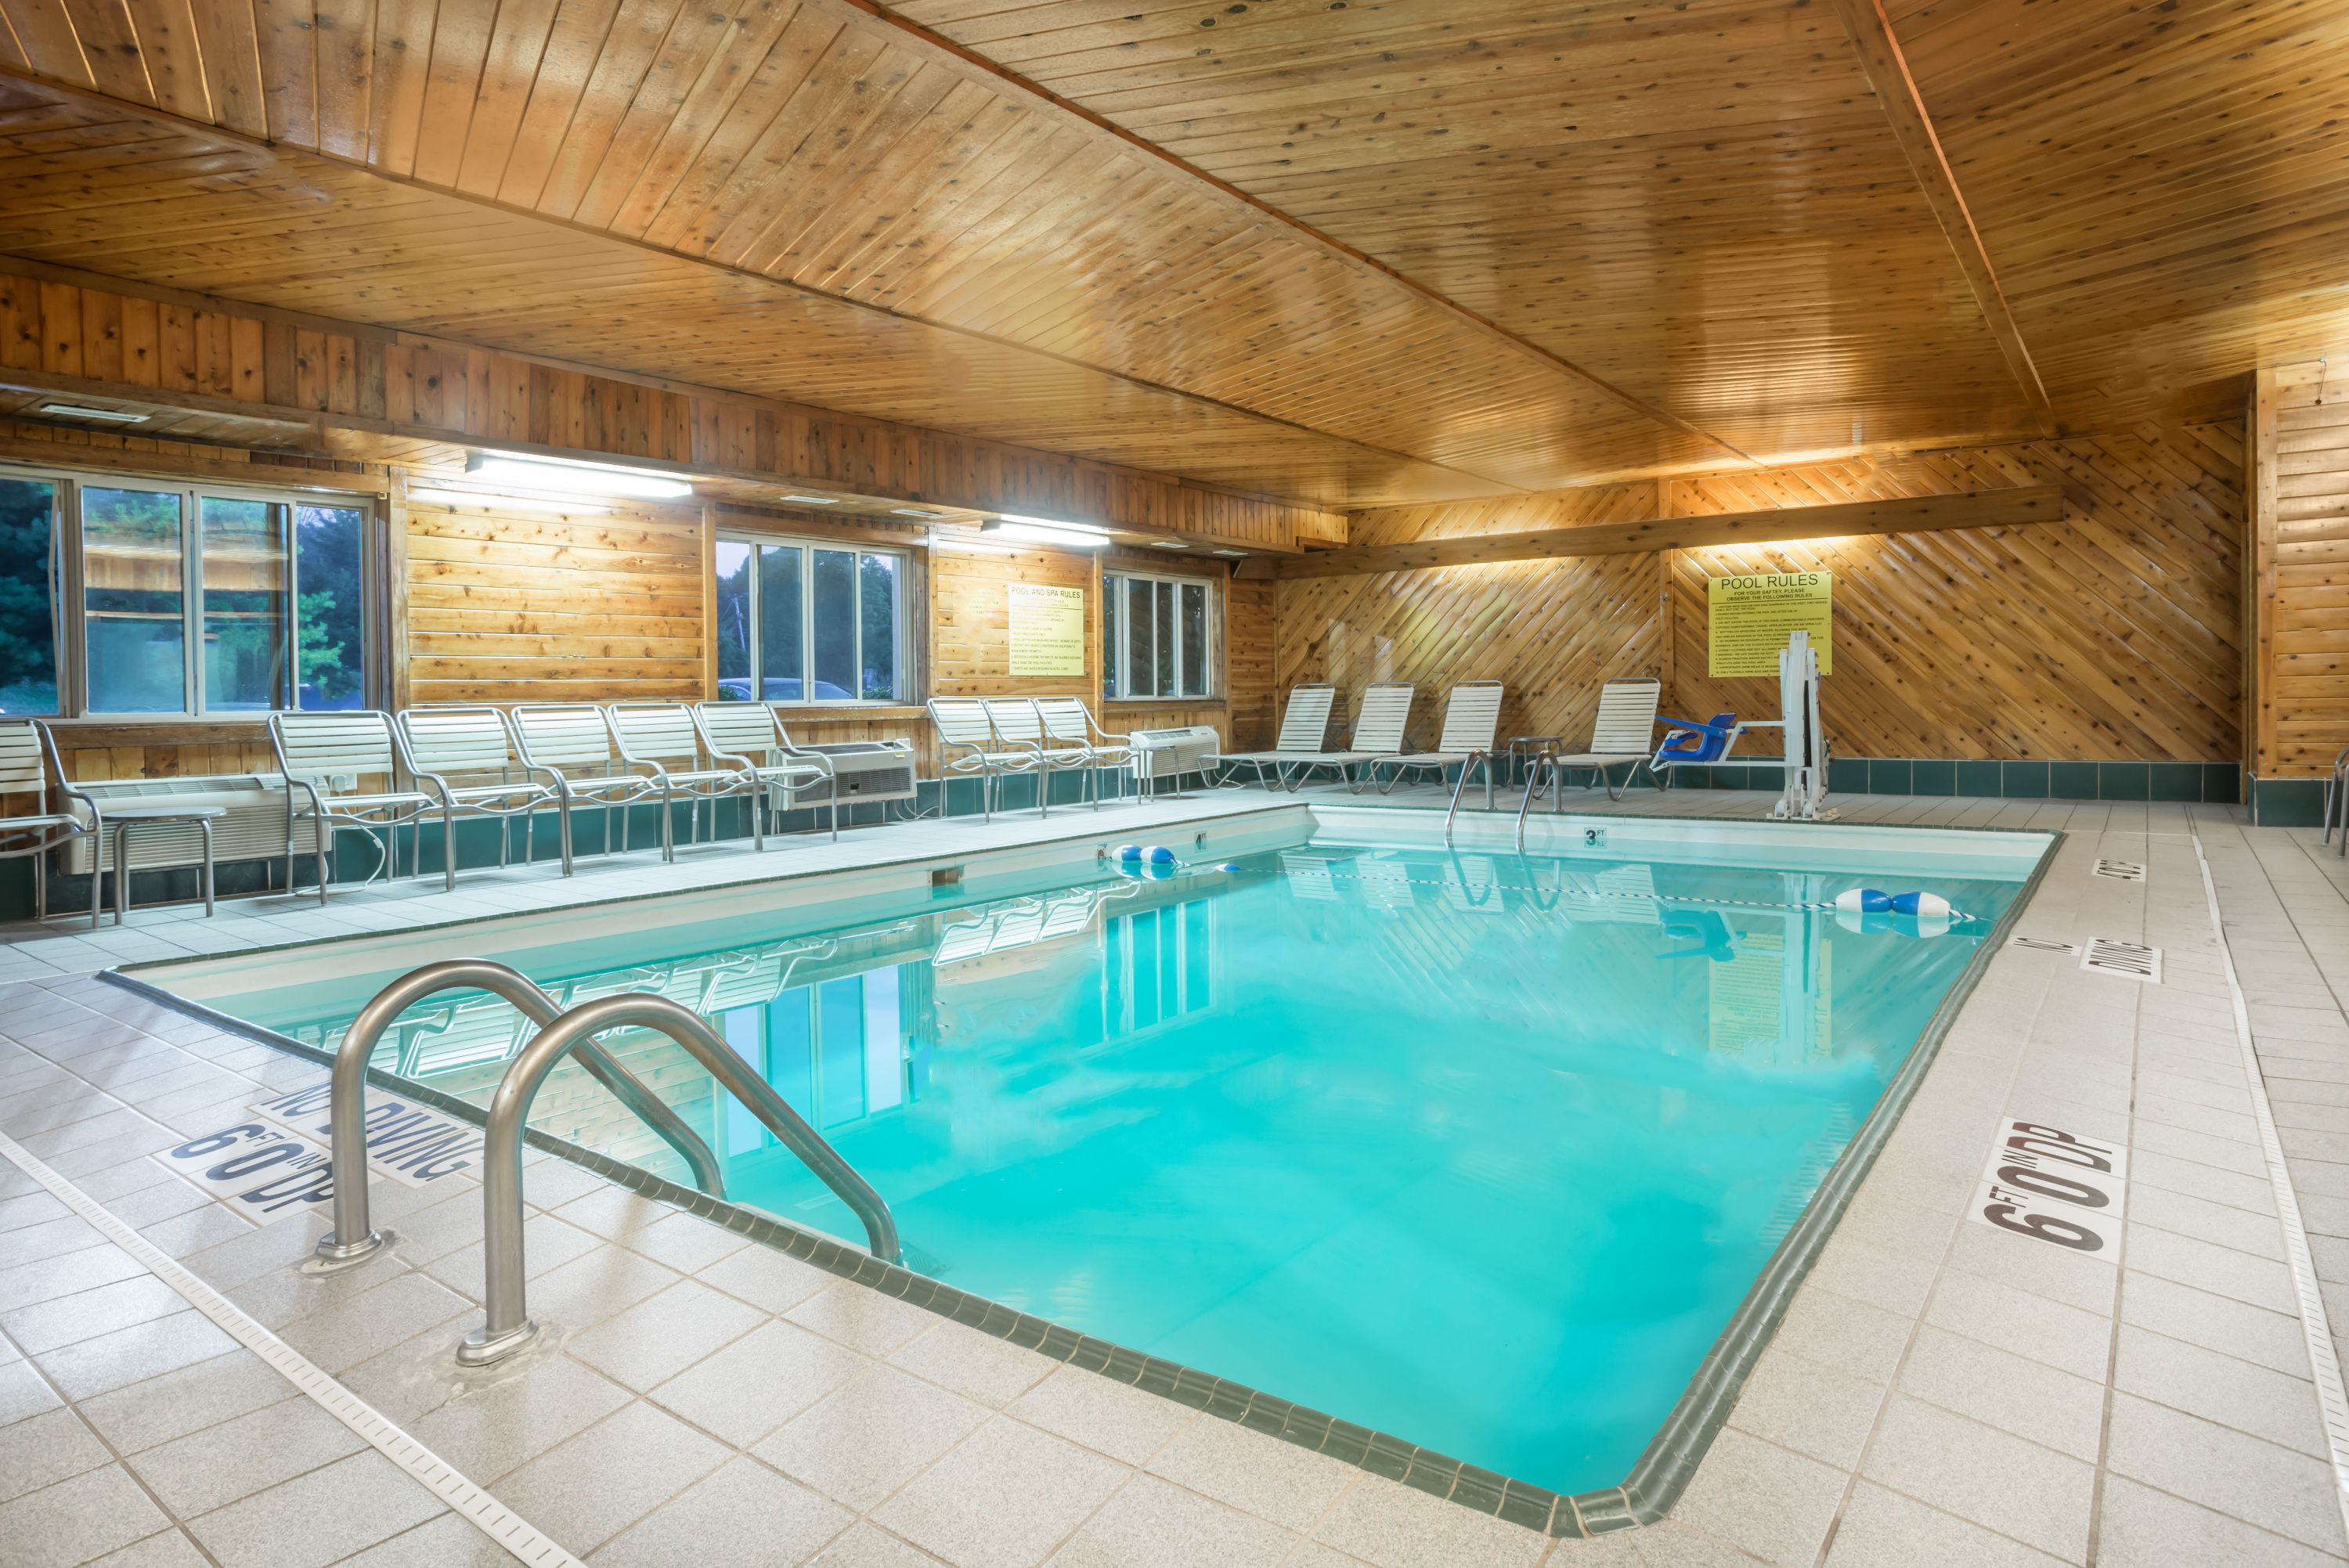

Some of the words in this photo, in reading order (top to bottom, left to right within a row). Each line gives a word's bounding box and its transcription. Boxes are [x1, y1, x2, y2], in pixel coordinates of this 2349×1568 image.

[1060, 590, 1081, 599] RULES
[1721, 577, 1762, 589] POOL
[1767, 574, 1818, 587] RULES
[1586, 830, 1596, 845] 3
[2013, 937, 2073, 954] NO
[2088, 939, 2153, 976] DIVING
[2006, 1122, 2113, 1173] DP
[1983, 1203, 2104, 1252] 6
